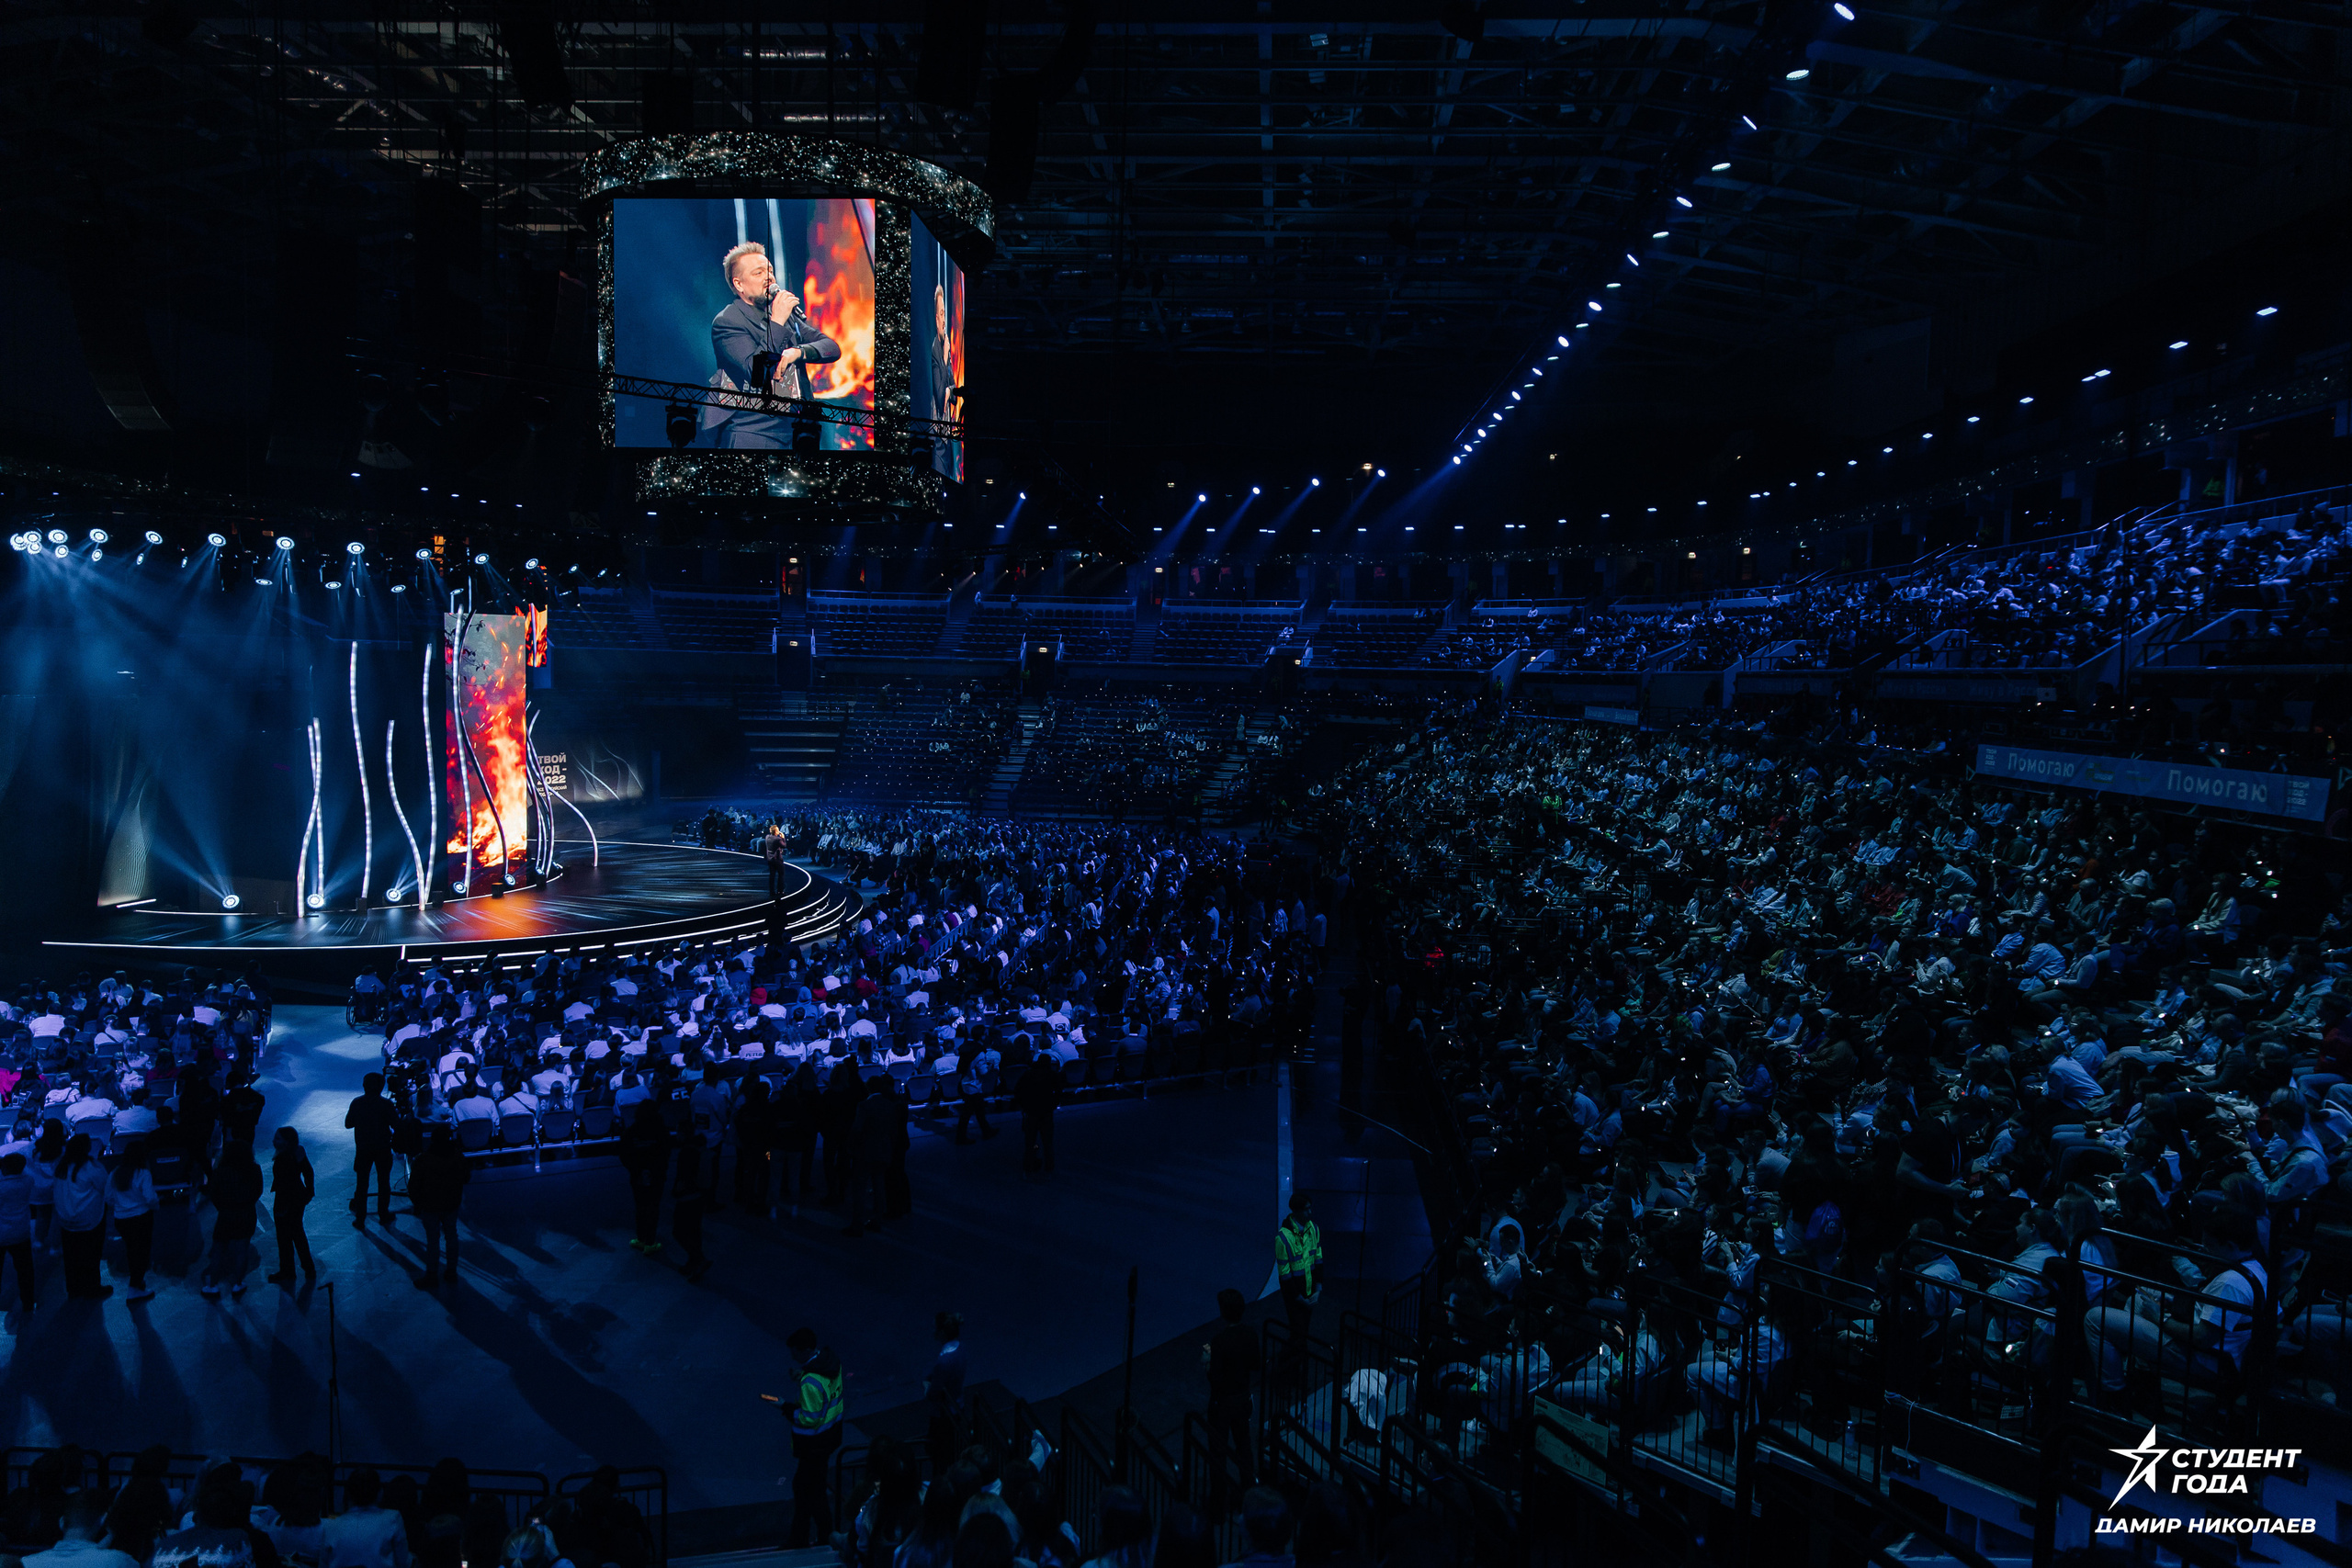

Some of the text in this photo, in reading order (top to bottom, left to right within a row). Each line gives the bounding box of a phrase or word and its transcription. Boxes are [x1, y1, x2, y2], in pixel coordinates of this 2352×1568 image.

[537, 752, 566, 764] ТВОЙ
[2007, 753, 2075, 778] Помогаю
[2167, 769, 2267, 803] Помогаю
